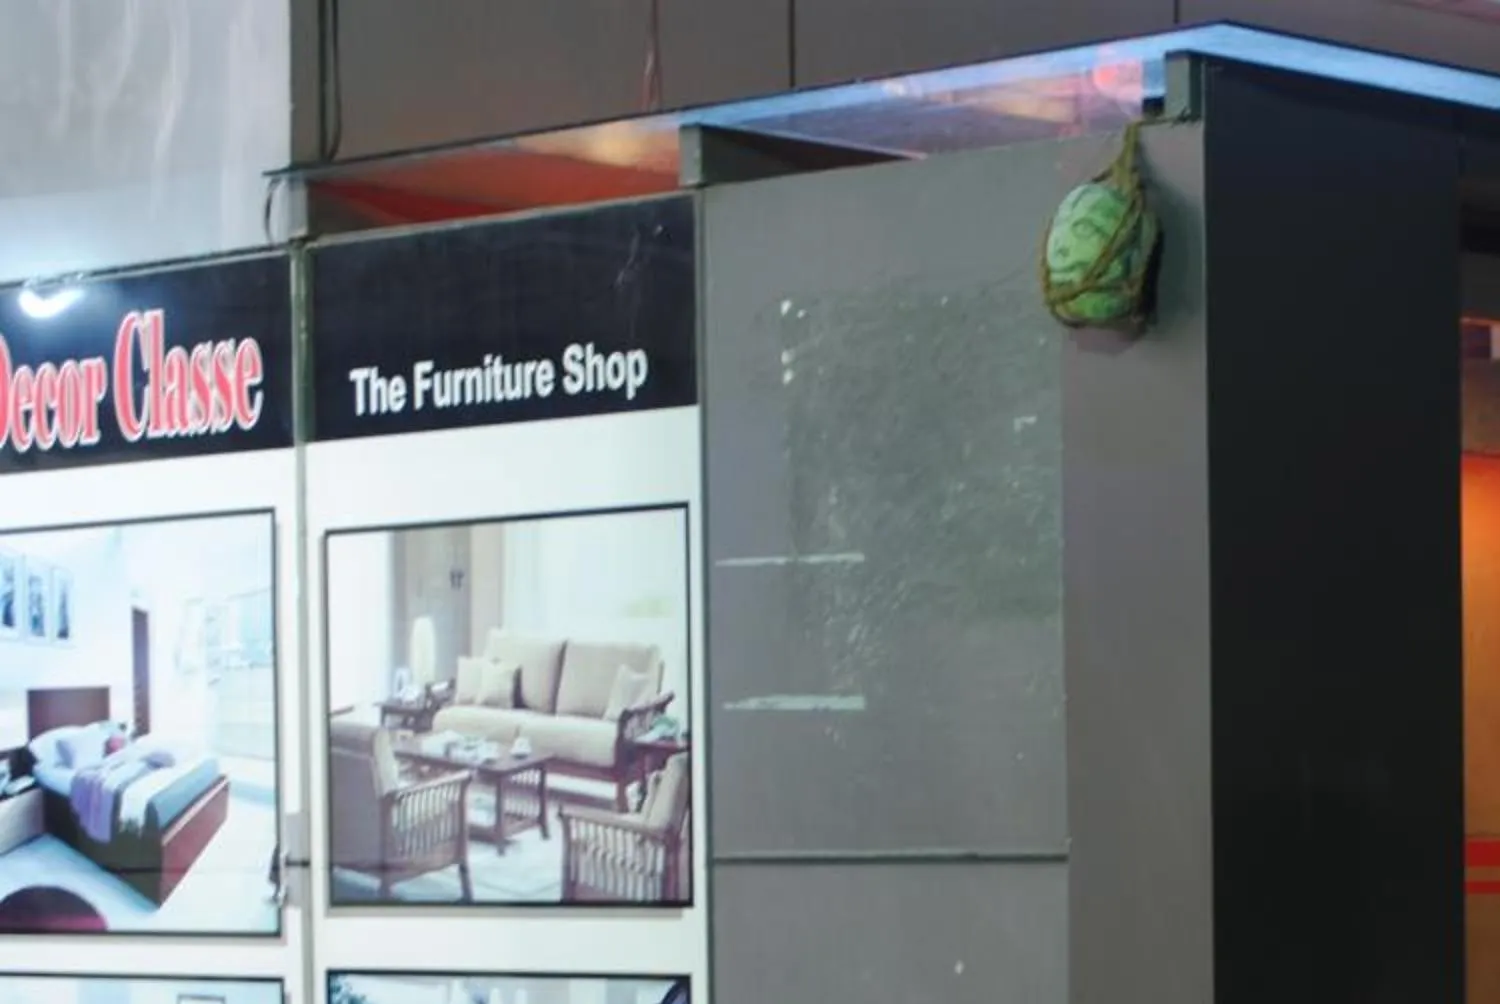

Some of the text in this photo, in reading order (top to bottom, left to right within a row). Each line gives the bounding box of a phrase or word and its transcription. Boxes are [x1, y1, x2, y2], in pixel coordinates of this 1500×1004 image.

[113, 309, 264, 442] Classe
[349, 342, 648, 416] The Furniture Shop
